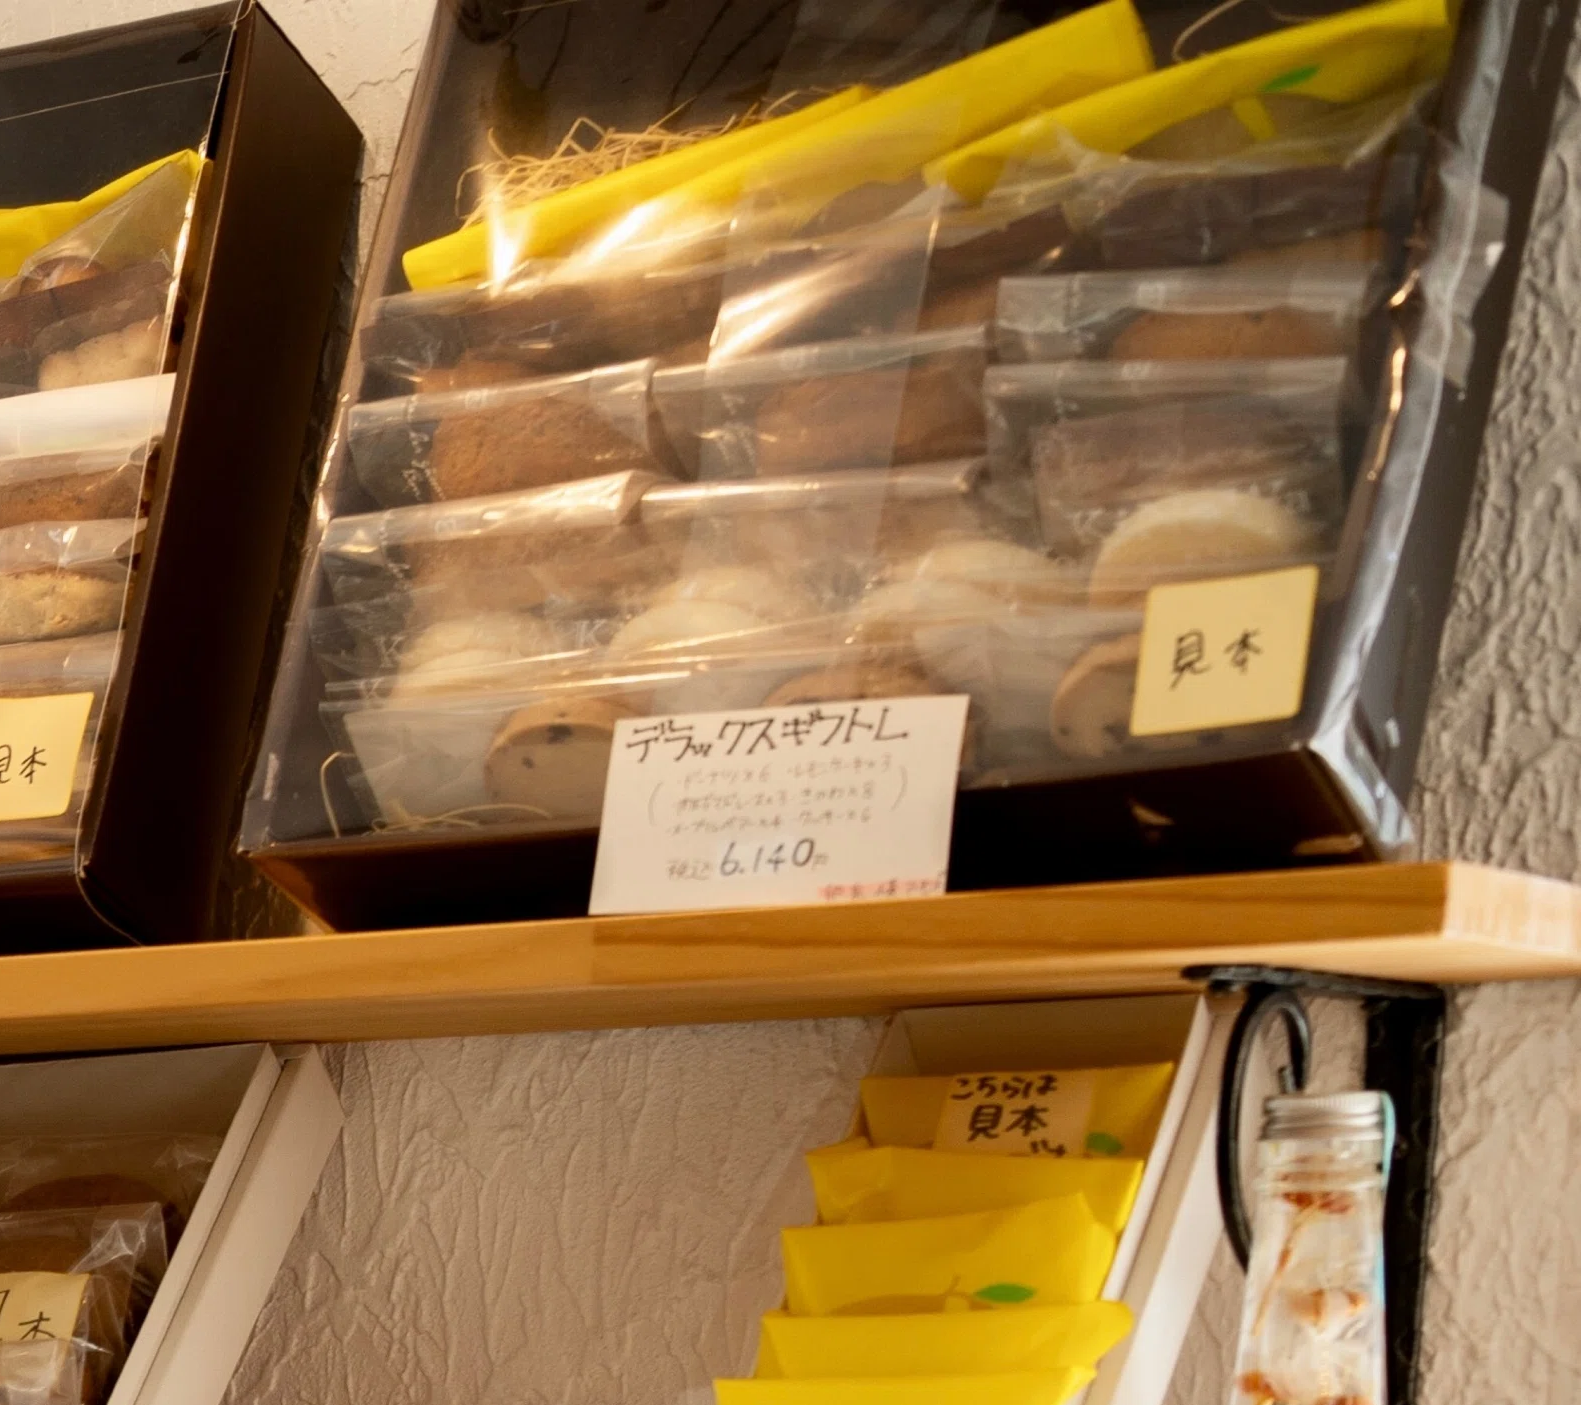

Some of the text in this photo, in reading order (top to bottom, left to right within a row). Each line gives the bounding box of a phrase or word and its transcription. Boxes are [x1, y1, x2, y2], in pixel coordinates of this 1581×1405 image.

[1168, 630, 1263, 689] 見本
[626, 706, 909, 763] デラックスギフトL
[950, 1074, 1058, 1101] こちらは
[967, 1104, 1049, 1142] 見本
